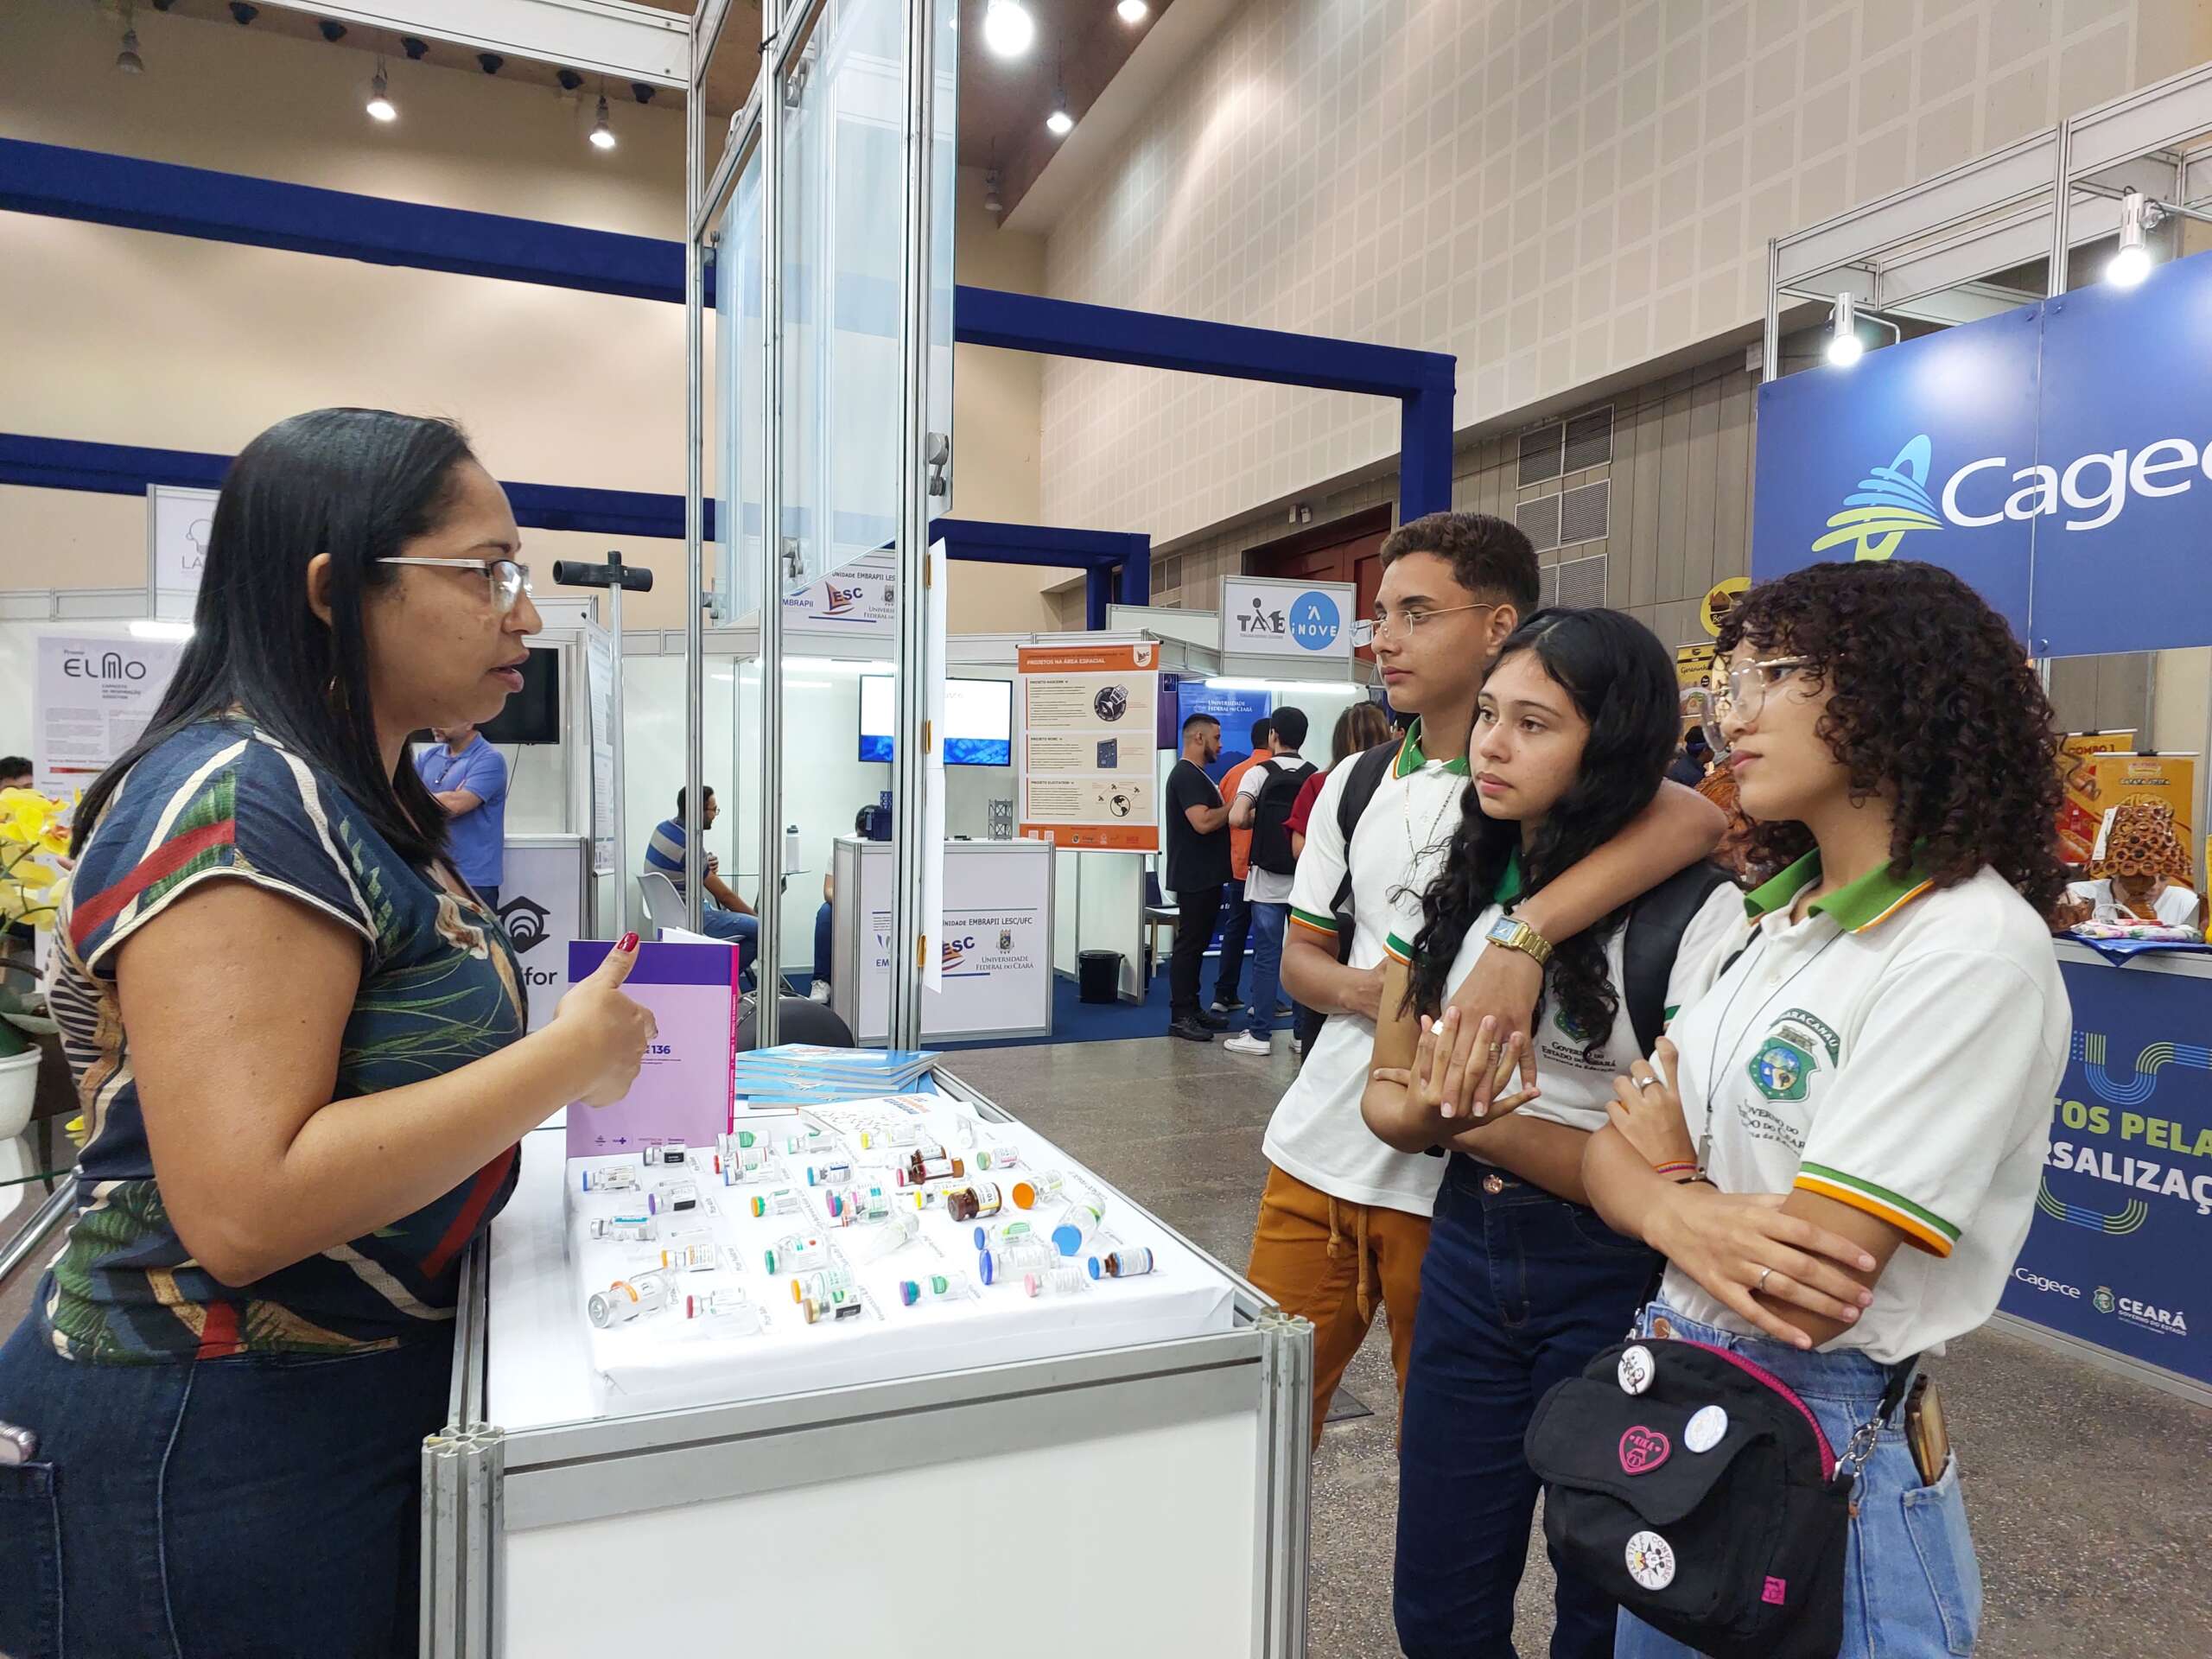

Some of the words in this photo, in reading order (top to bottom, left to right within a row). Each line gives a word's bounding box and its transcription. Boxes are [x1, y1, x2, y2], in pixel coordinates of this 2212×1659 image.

[1942, 438, 2212, 531] Cage
[181, 556, 204, 569] LA
[857, 572, 884, 581] EMBRAPII
[783, 599, 814, 607] MBRAPII
[64, 652, 146, 679] ELMO
[969, 918, 1000, 926] EMBRAPII
[943, 936, 976, 955] ESC
[876, 958, 890, 967] EM
[982, 956, 1029, 964] UNIVERSIDADE
[524, 966, 558, 985] for
[1782, 1010, 1839, 1048] ARACANAU
[652, 1045, 671, 1054] 136
[1552, 1041, 1592, 1057] GOVERN
[1777, 1126, 1806, 1149] CEAR
[2121, 1111, 2212, 1158] PELA
[2015, 1268, 2082, 1299] Cagece
[2119, 1297, 2187, 1331] CEARÁ
